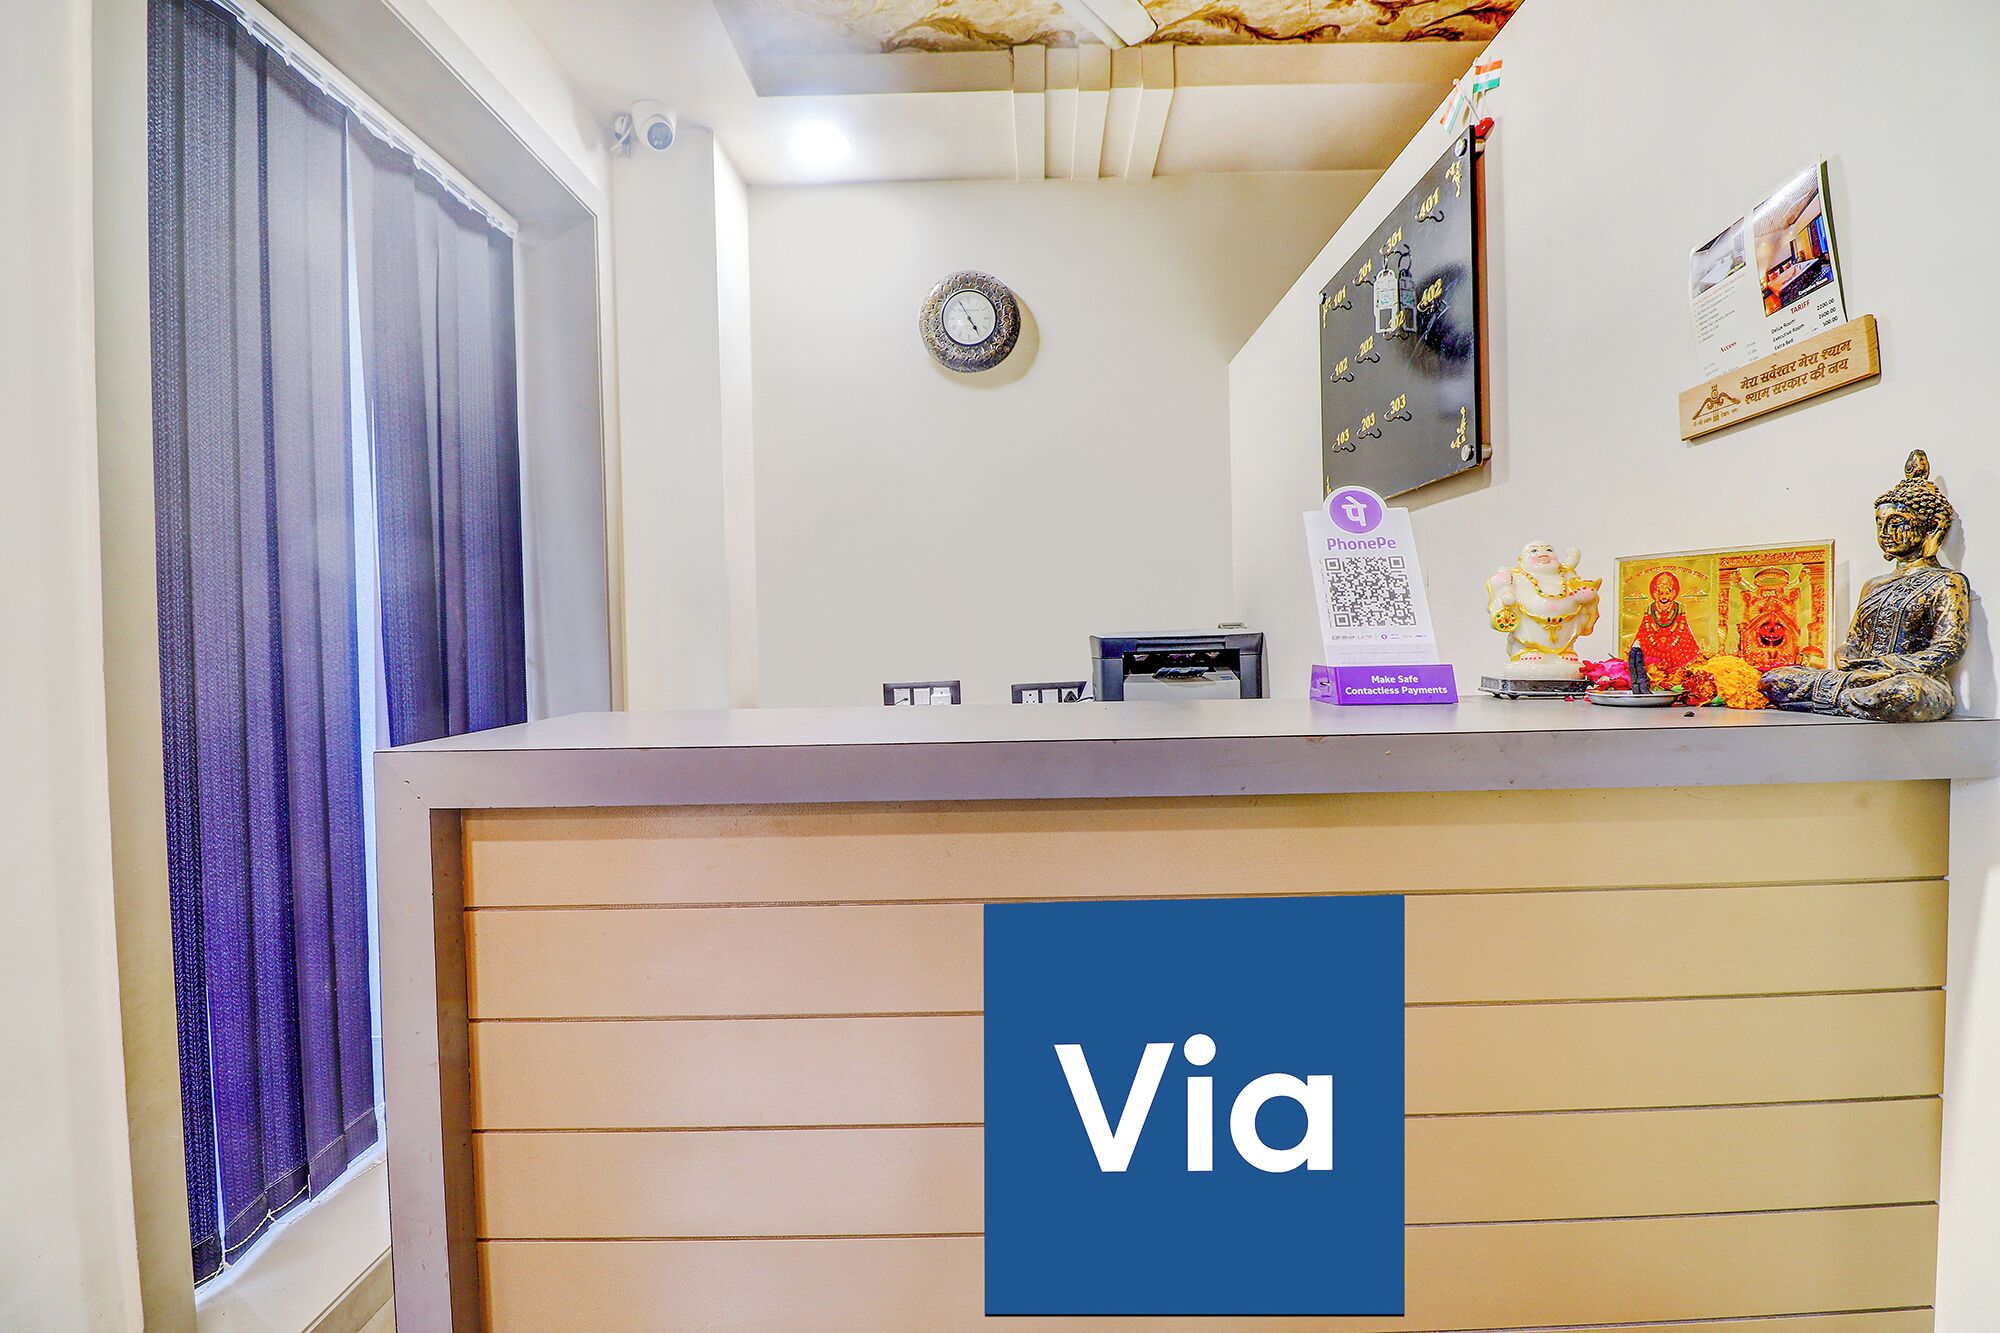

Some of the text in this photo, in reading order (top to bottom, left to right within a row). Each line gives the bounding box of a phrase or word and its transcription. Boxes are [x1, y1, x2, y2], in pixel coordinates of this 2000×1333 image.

[1419, 187, 1440, 218] 401
[1386, 227, 1403, 251] 301
[1358, 259, 1373, 283] 201
[1333, 285, 1347, 307] 101
[1421, 278, 1443, 305] 402
[1790, 300, 1810, 314] TARIFF
[1359, 335, 1375, 357] 202
[1334, 357, 1349, 376] 102
[1740, 377, 1759, 389] मेरा
[1798, 352, 1819, 368] मेरा
[1390, 393, 1407, 414] 303
[1361, 412, 1376, 432] 203
[1336, 429, 1350, 446] 103
[1327, 536, 1397, 551] PhonePe
[1371, 674, 1418, 684] Make Safe
[1345, 685, 1448, 696] Contactless Payments
[1053, 1033, 1333, 1173] Via
